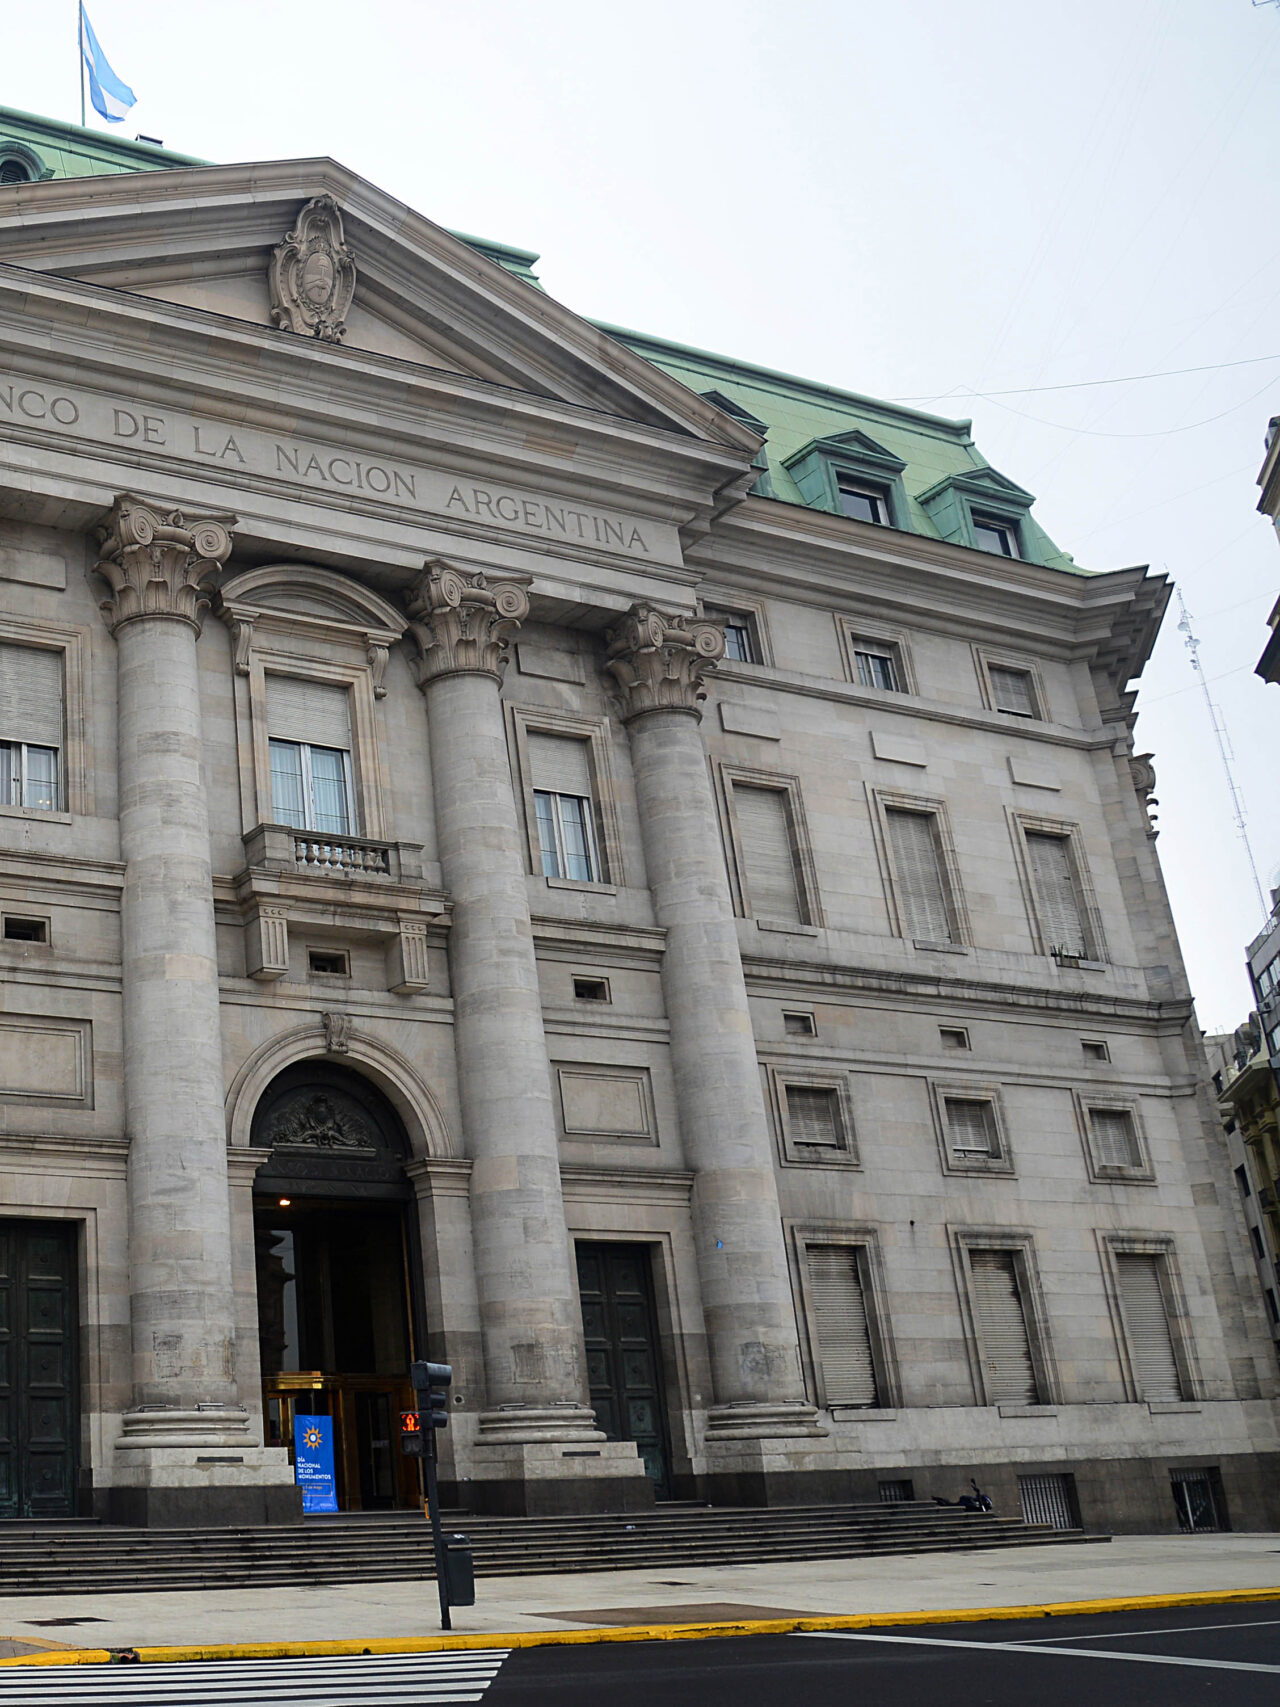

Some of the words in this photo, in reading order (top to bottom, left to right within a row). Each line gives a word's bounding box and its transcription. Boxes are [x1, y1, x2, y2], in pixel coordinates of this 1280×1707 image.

[113, 408, 167, 447] DE
[192, 425, 247, 464] LA
[274, 444, 417, 500] NACION
[446, 485, 650, 553] ARGENTINA
